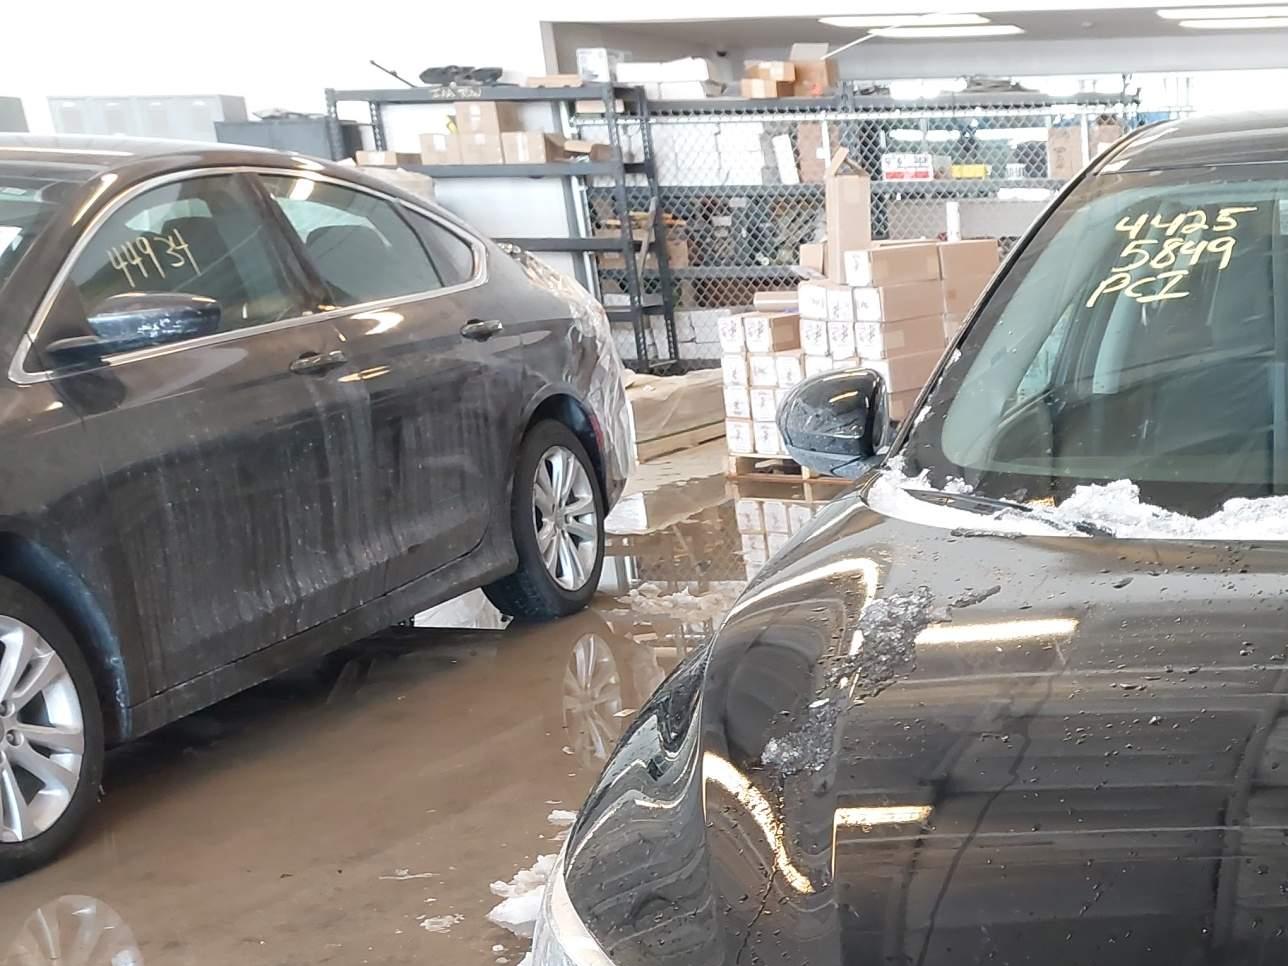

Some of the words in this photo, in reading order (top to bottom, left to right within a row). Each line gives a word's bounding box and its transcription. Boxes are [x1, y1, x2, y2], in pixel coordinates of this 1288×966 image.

[1114, 206, 1258, 240] 4425
[105, 227, 202, 288] 44934
[1110, 236, 1236, 273] 5849
